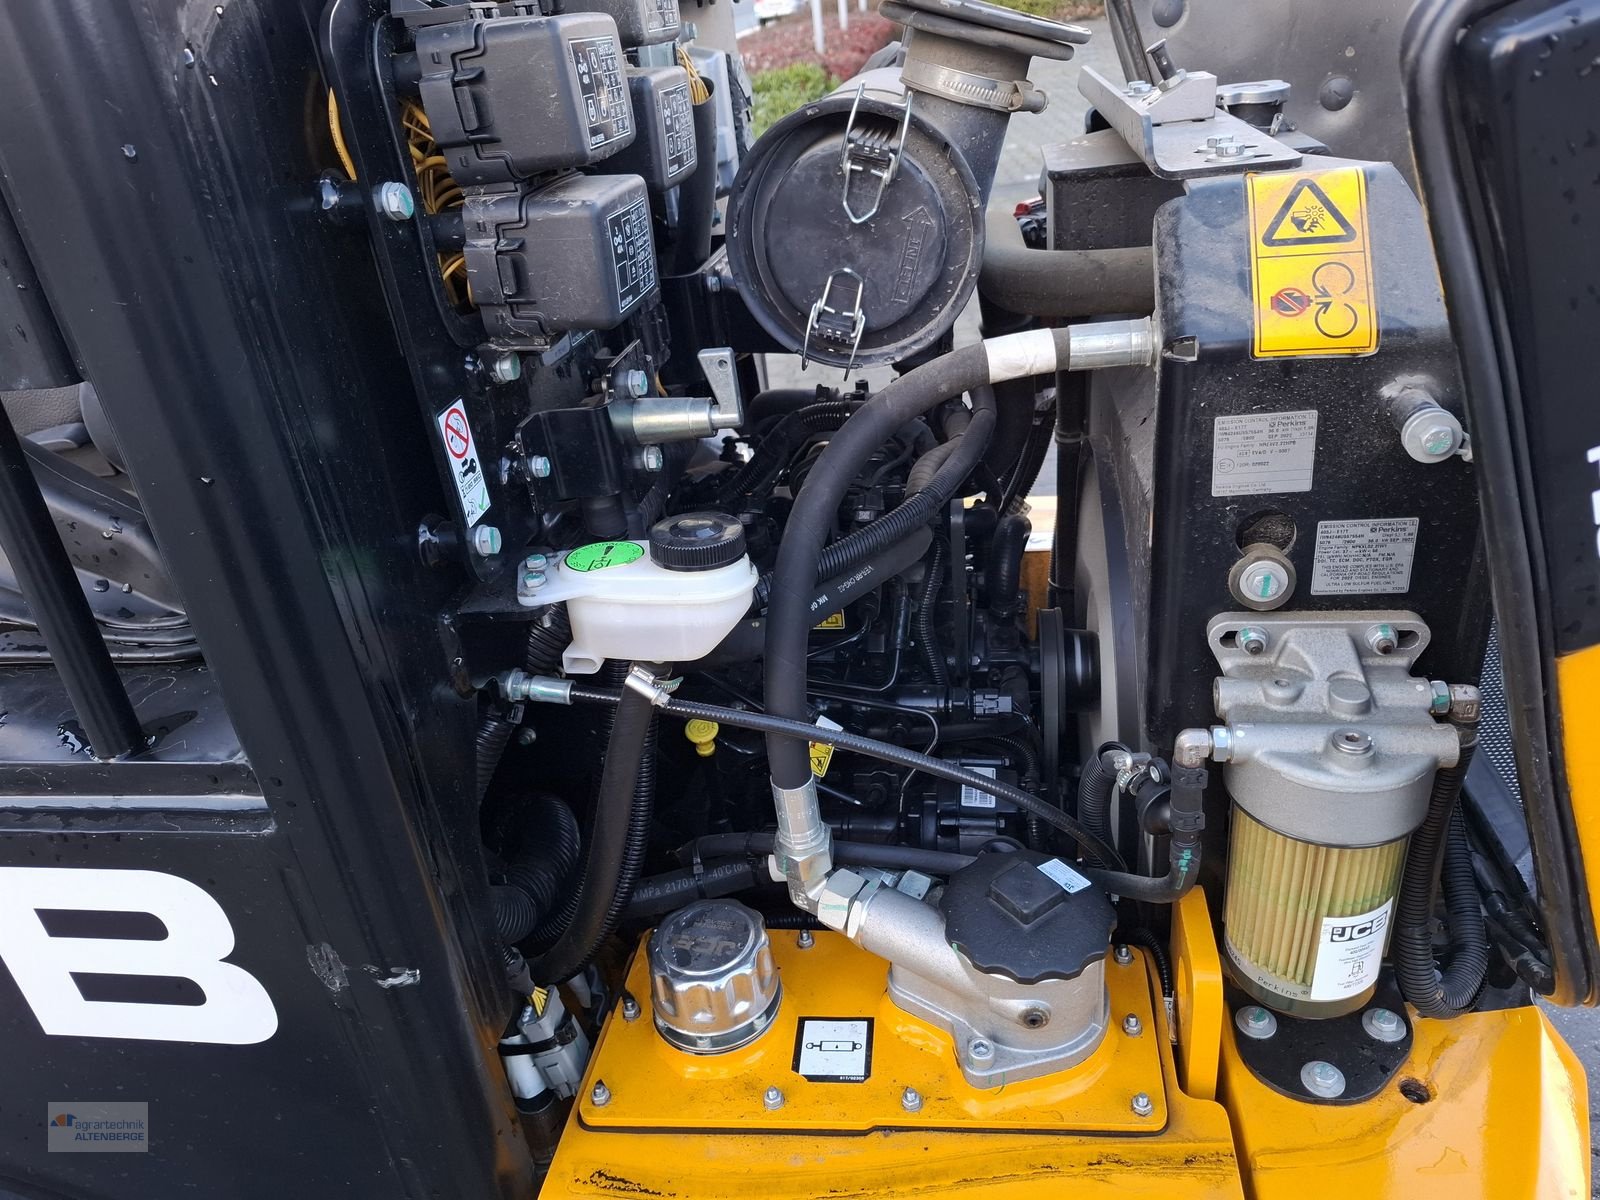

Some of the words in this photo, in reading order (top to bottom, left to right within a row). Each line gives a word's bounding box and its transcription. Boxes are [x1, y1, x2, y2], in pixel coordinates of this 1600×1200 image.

[641, 886, 661, 900] MPa
[665, 878, 689, 893] 2170
[1331, 911, 1388, 942] JCB
[1258, 976, 1298, 998] Perkins
